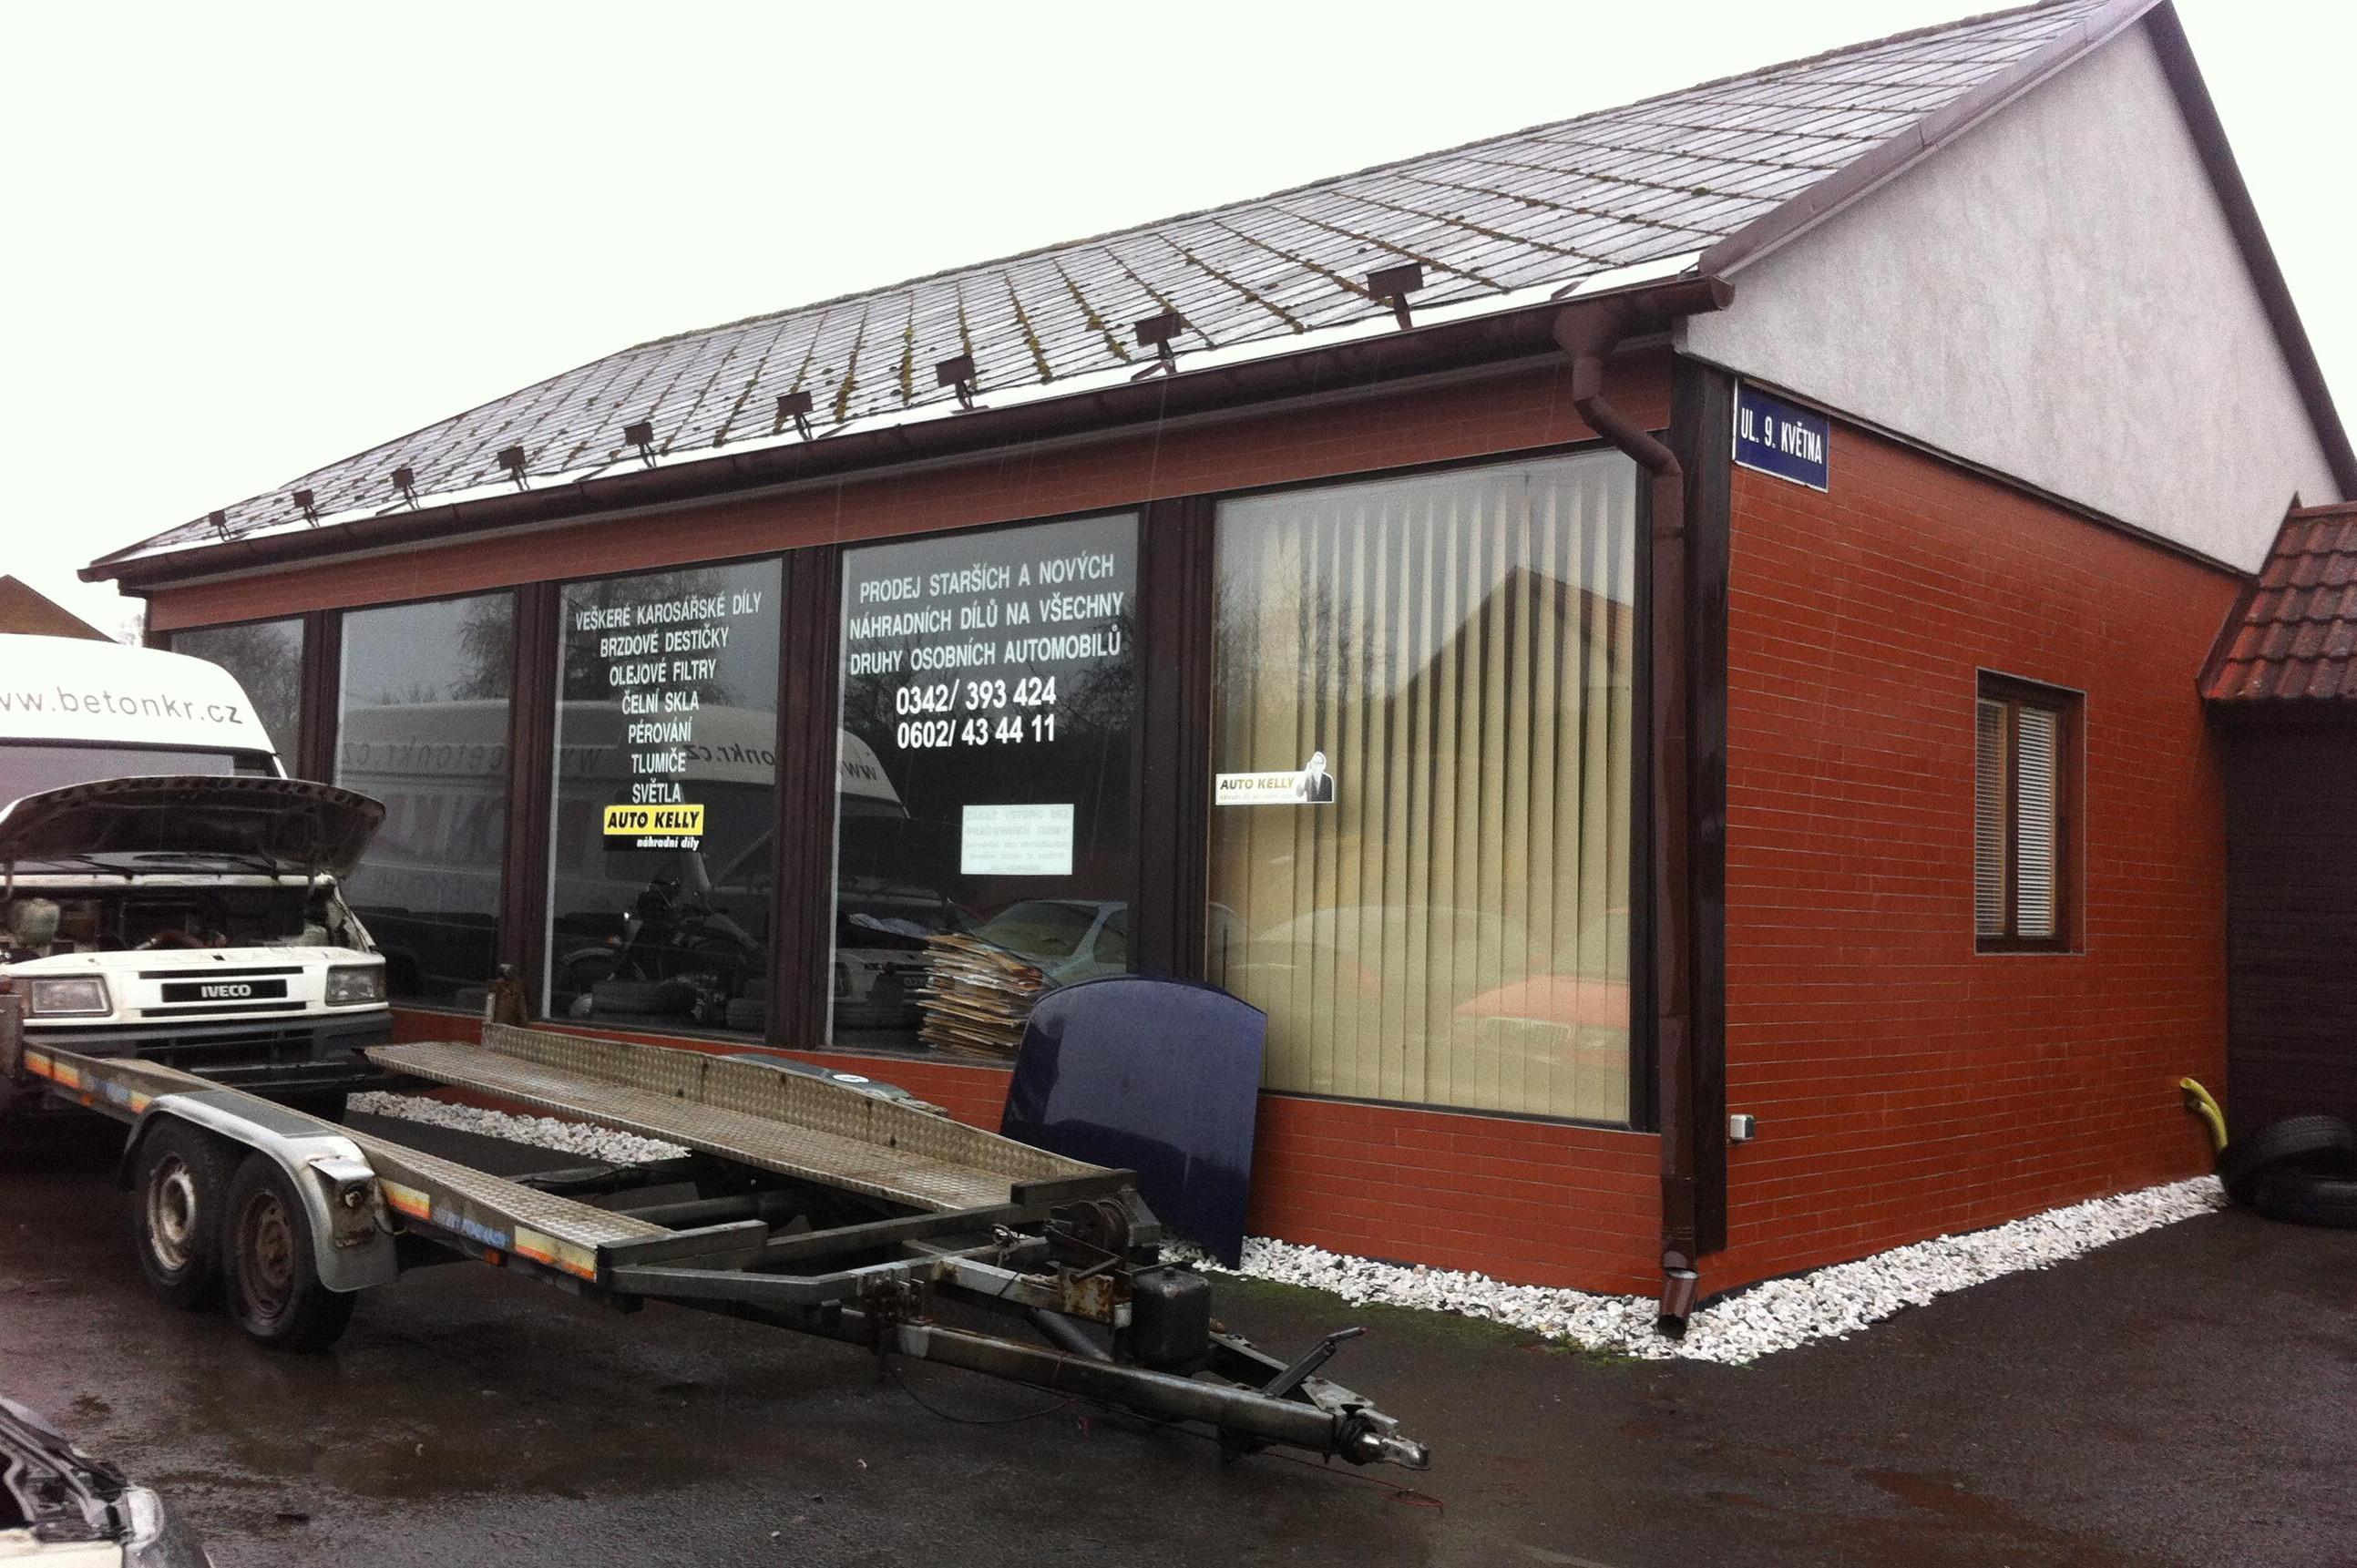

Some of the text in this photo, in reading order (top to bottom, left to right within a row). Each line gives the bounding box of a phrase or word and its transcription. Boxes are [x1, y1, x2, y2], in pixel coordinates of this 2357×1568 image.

[1741, 407, 1822, 465] UL. 9. KVĚTNA
[860, 549, 1113, 603] PRODEJ STARŠÍCH A NOVÝCH
[576, 589, 762, 630] VEŠKERÉ KAROSÁŘSKÉ DÍLY
[850, 591, 1124, 640] NÁHRADNÍCH DÍLŮ NA VŠECHNY
[600, 623, 729, 657] BRZDOVÉ DESTIČKY
[850, 624, 1121, 675] DRUHY OSOBNÍCH AUTOMOBILŮ
[610, 657, 716, 686] OLEJOVÉ FILTRY
[622, 688, 699, 715] ČELNÍ SKLA
[897, 676, 1057, 715] 0342/ 393 424
[628, 716, 692, 743] PÉROVÁNÍ
[897, 713, 1054, 749] 0602/ 43 44 11
[631, 747, 686, 774] TLUMIČE
[632, 777, 681, 804] SVĚTLA
[1220, 777, 1296, 790] AUTO KELLY
[608, 811, 700, 828] AUTO KELLY
[201, 984, 251, 998] IVECO
